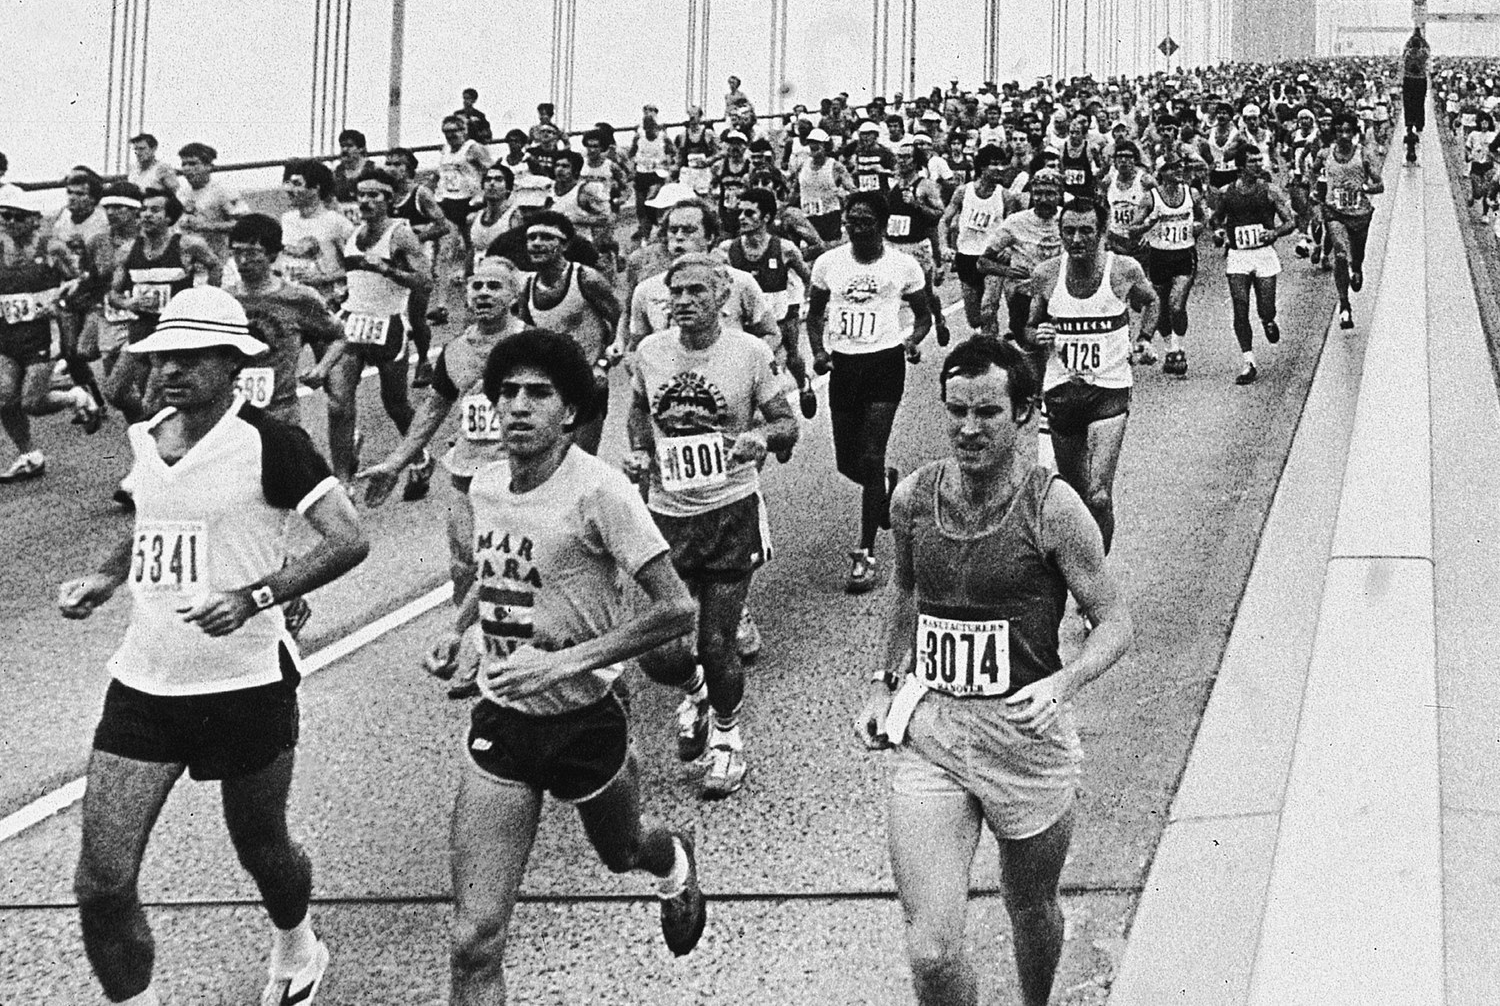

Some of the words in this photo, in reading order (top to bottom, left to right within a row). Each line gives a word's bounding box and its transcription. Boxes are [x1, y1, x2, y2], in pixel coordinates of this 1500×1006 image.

[840, 311, 876, 337] 5177
[1058, 342, 1101, 370] 4726
[134, 534, 198, 584] 5341
[475, 530, 534, 562] MAR
[925, 630, 999, 686] 3074
